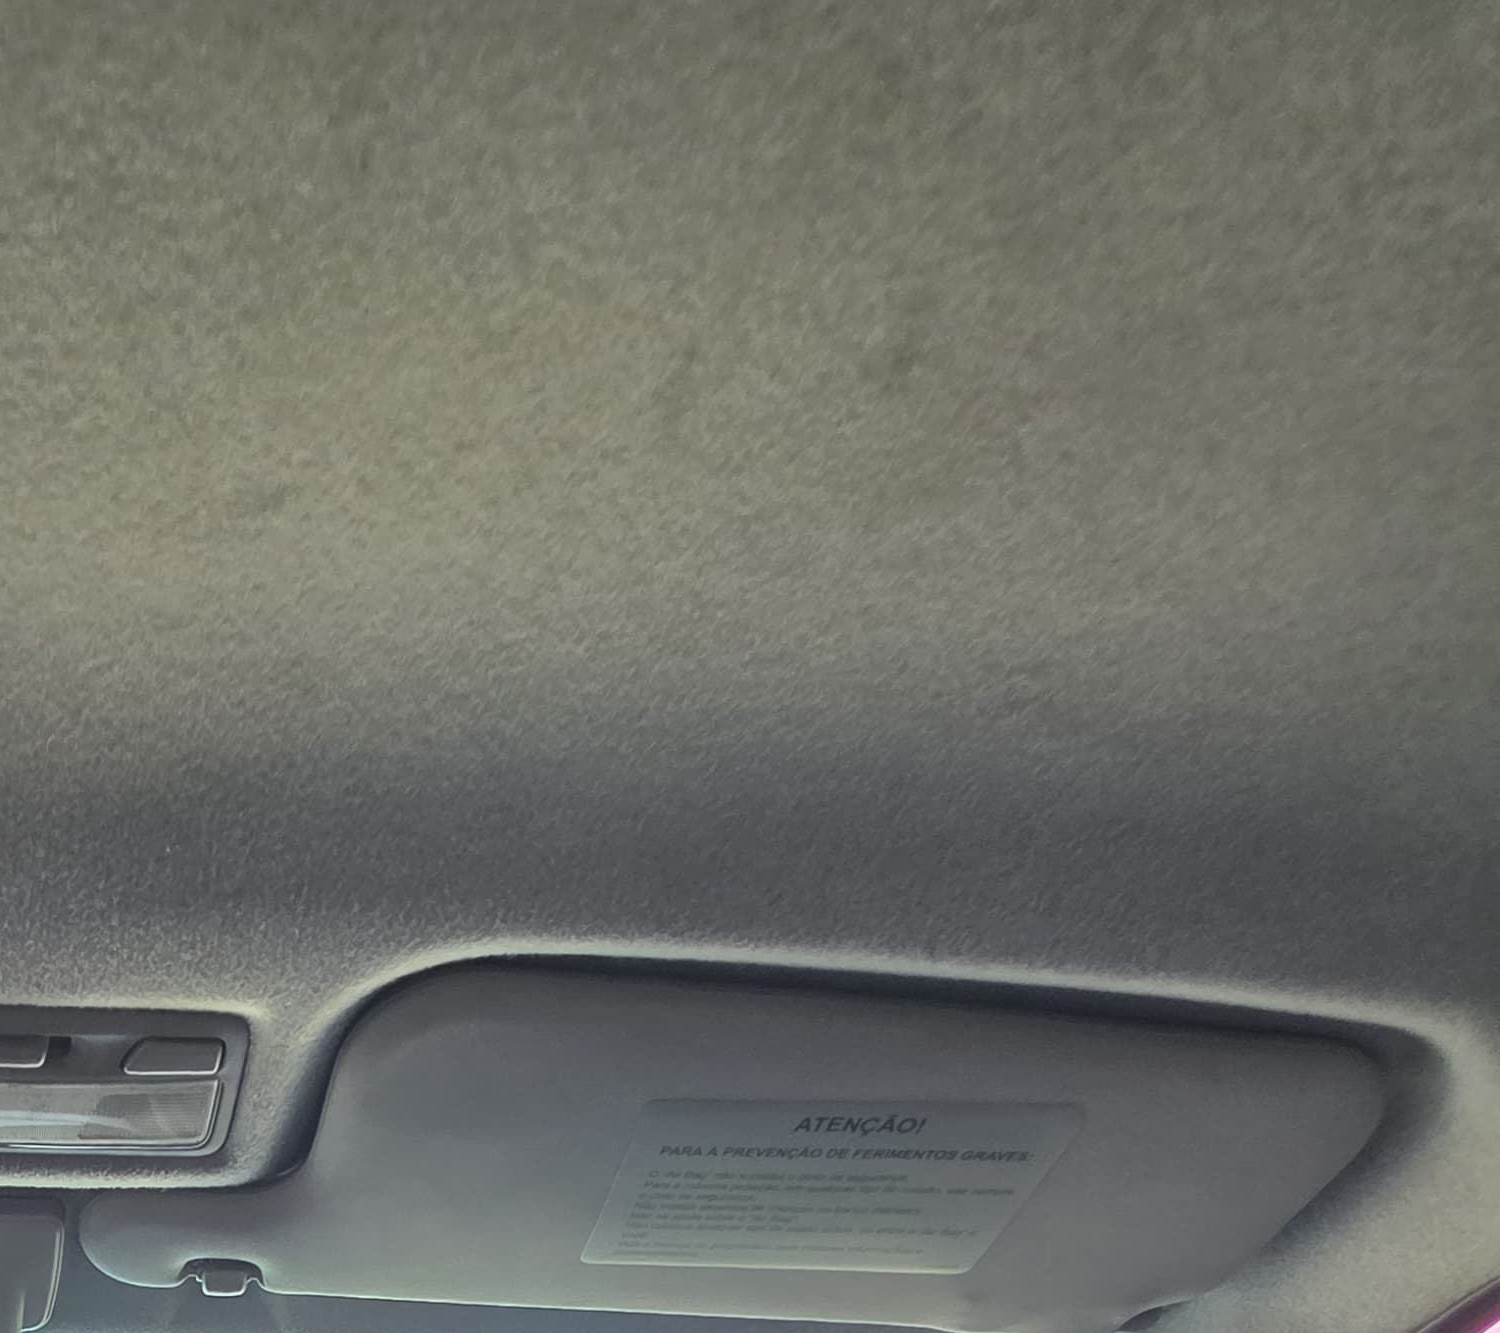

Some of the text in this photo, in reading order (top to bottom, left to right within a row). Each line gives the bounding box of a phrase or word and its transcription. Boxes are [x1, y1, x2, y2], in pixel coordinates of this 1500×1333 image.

[793, 1114, 928, 1136] ATENÇÃO!
[659, 1145, 703, 1158] PARA
[706, 1146, 719, 1157] A
[723, 1145, 821, 1162] PREVENÇÃO
[825, 1148, 847, 1160] DE
[852, 1148, 957, 1162] FERIMENTOS
